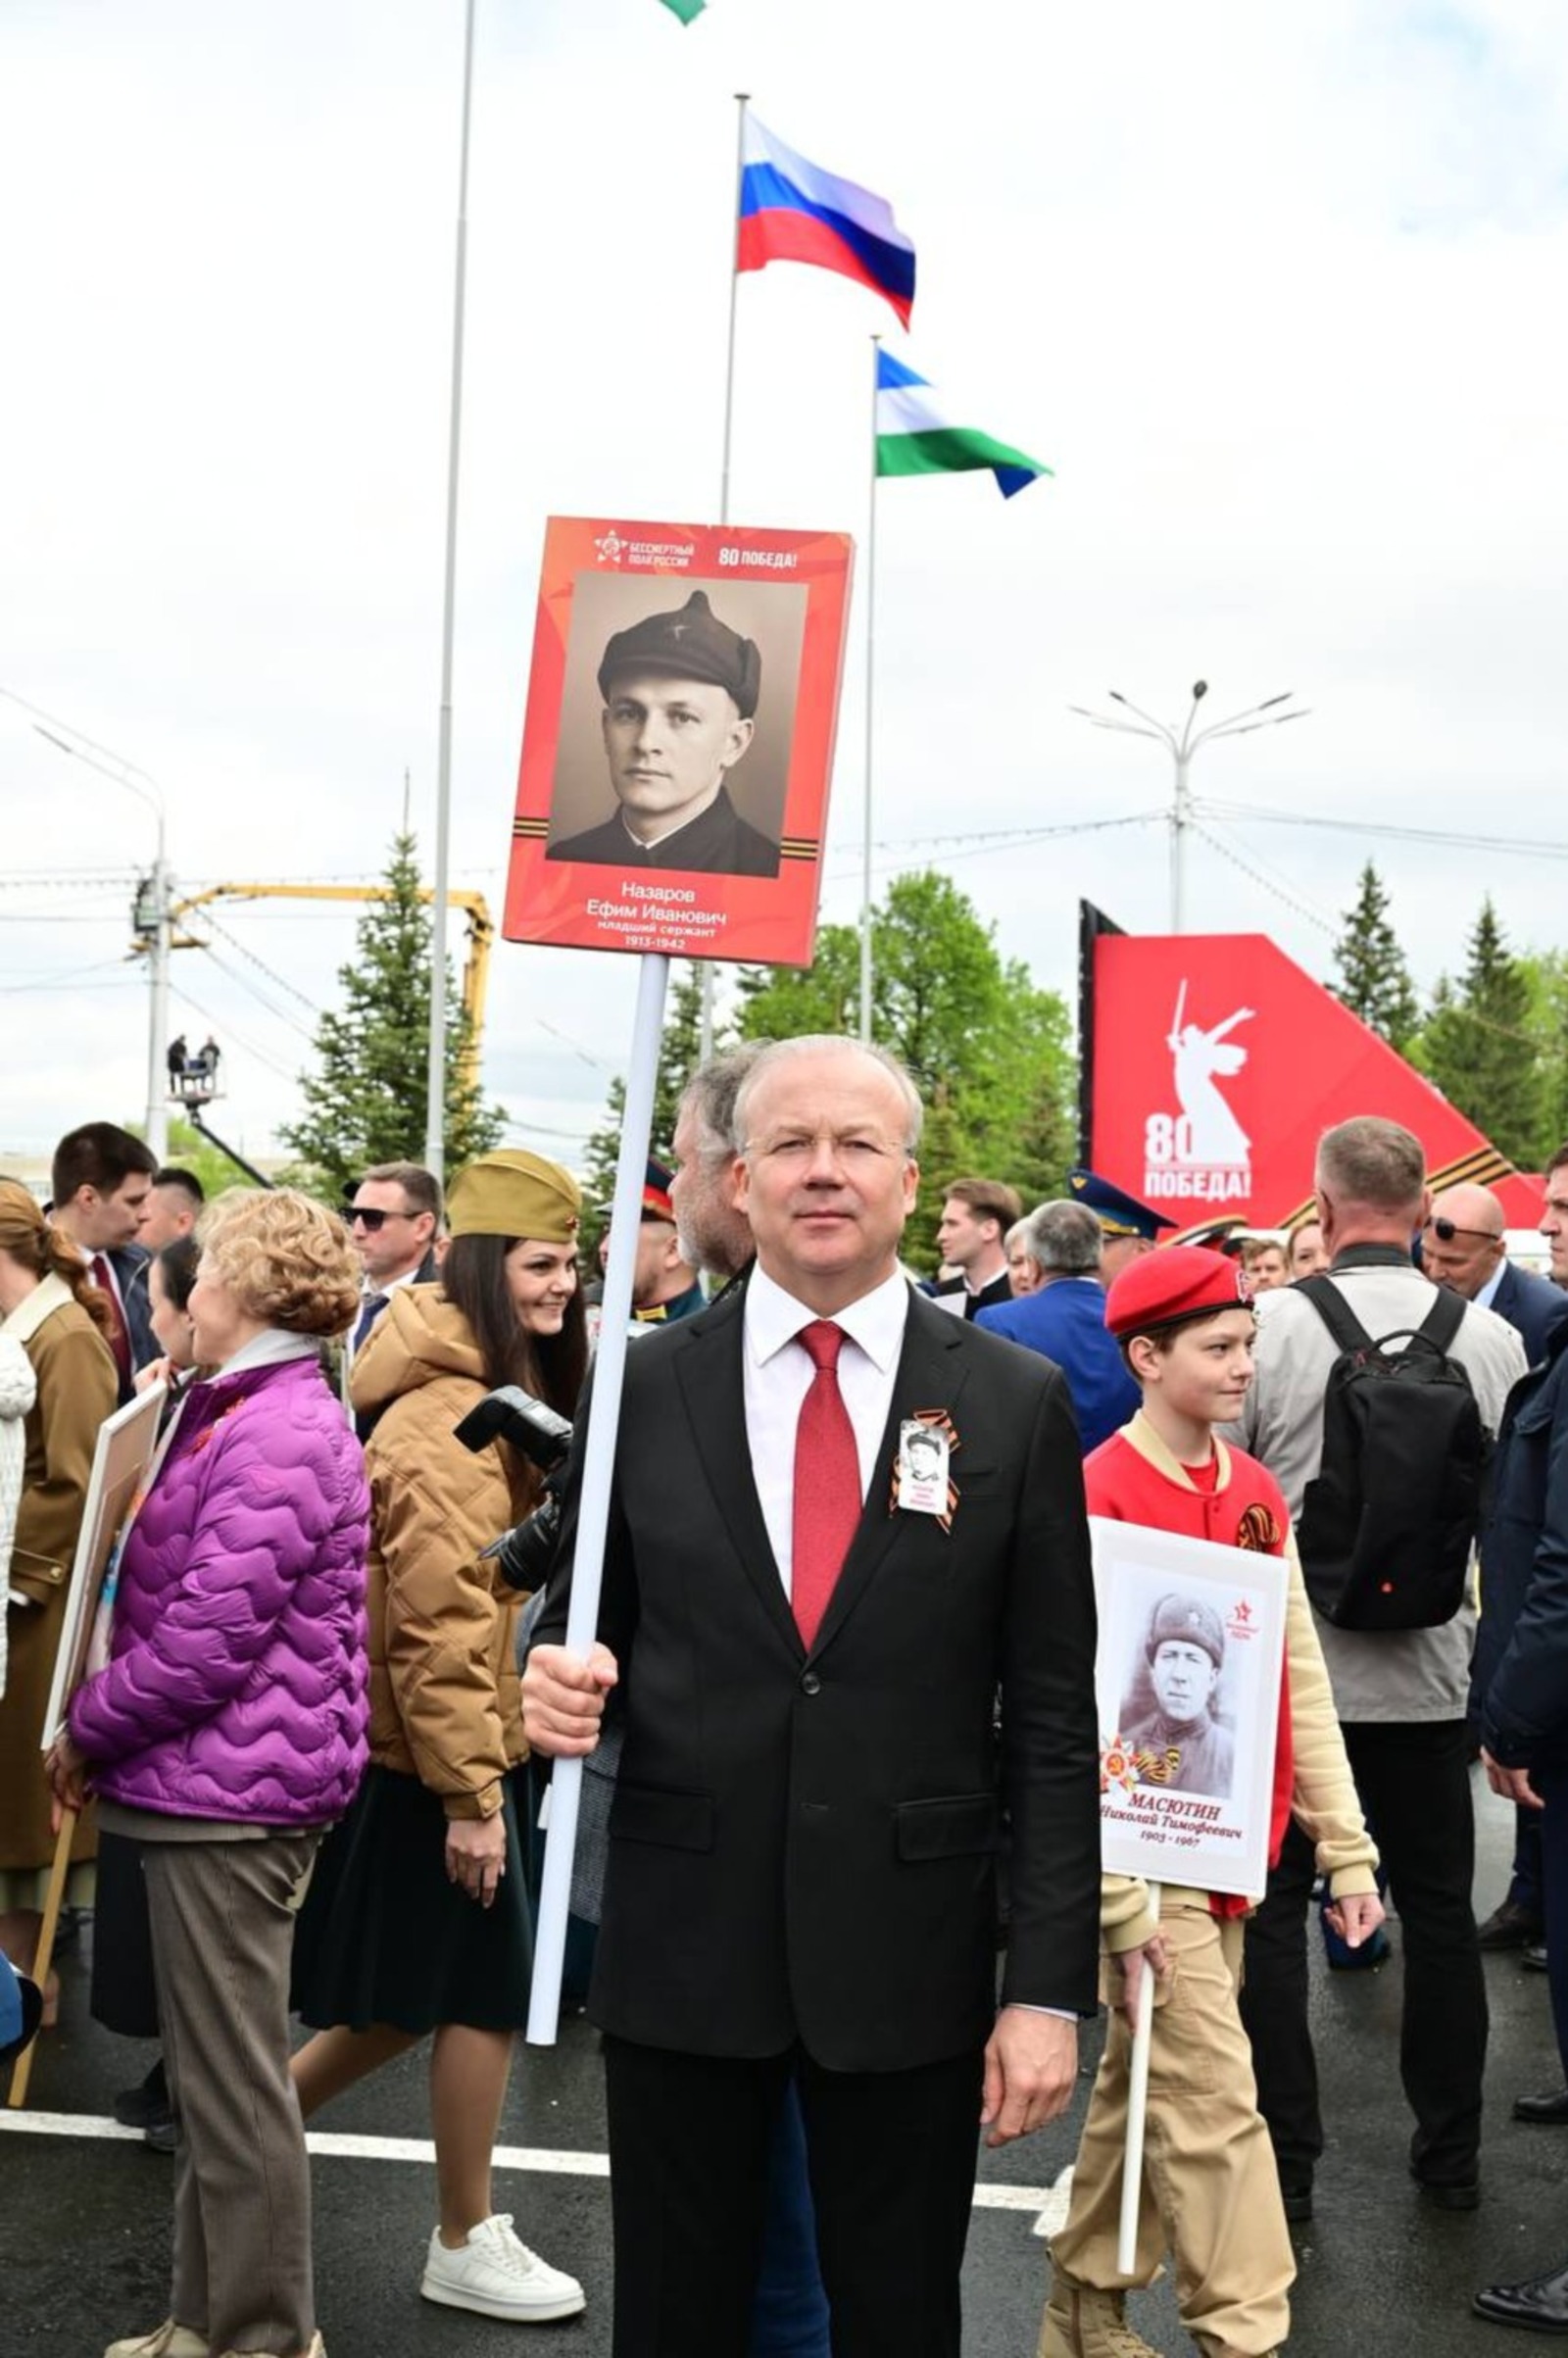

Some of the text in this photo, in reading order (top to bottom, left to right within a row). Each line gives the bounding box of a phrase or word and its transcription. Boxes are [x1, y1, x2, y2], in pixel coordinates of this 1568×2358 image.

[719, 547, 798, 569] 80 ПОБЕДА!
[621, 881, 695, 904] Назаров
[587, 899, 727, 925] Ефим Иванович
[598, 920, 715, 938] младший сержант
[1145, 1112, 1198, 1164] 80
[1145, 1170, 1251, 1203] ПОБЕДА!
[1128, 1793, 1222, 1821] МАСЮТИН
[1100, 1805, 1243, 1840] Николай Тимофеевич
[1141, 1831, 1166, 1843] 1903
[1174, 1835, 1200, 1848] 1967
